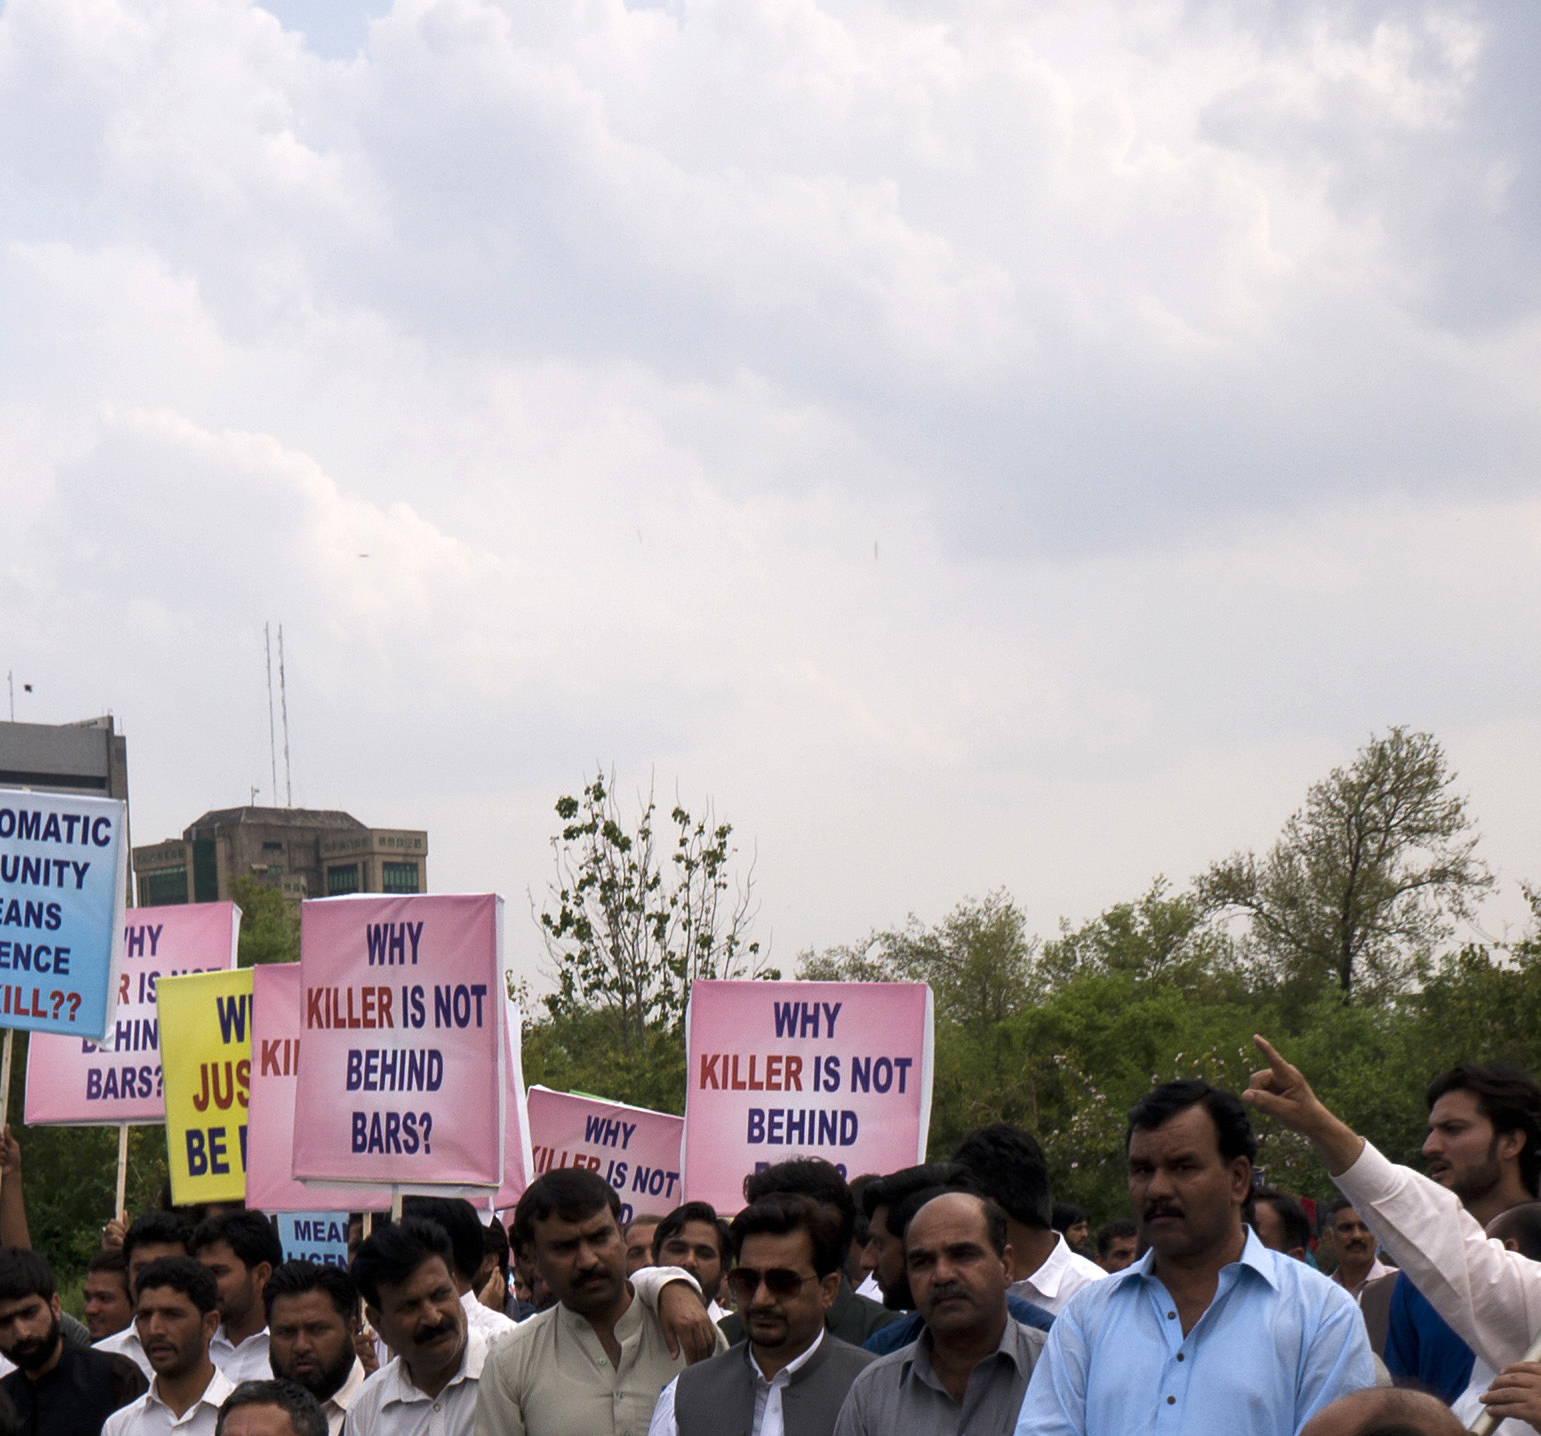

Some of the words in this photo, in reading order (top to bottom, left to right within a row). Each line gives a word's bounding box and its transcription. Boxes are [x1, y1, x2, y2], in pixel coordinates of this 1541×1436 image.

[124, 924, 163, 958] HY
[366, 921, 423, 966] WHY
[307, 986, 393, 1029] KILLER
[402, 985, 426, 1028] IS
[434, 984, 487, 1028] NOT
[774, 1001, 842, 1038] WHY
[346, 1049, 443, 1092] BEHIND
[700, 1054, 803, 1092] KILLER
[813, 1056, 840, 1092] IS
[851, 1057, 912, 1095] NOT
[351, 1111, 433, 1155] BARS?
[585, 1115, 636, 1149] WHY
[747, 1108, 858, 1146] BEHIND
[186, 1126, 230, 1177] BE
[607, 1160, 628, 1189] IS
[632, 1165, 679, 1198] NOT
